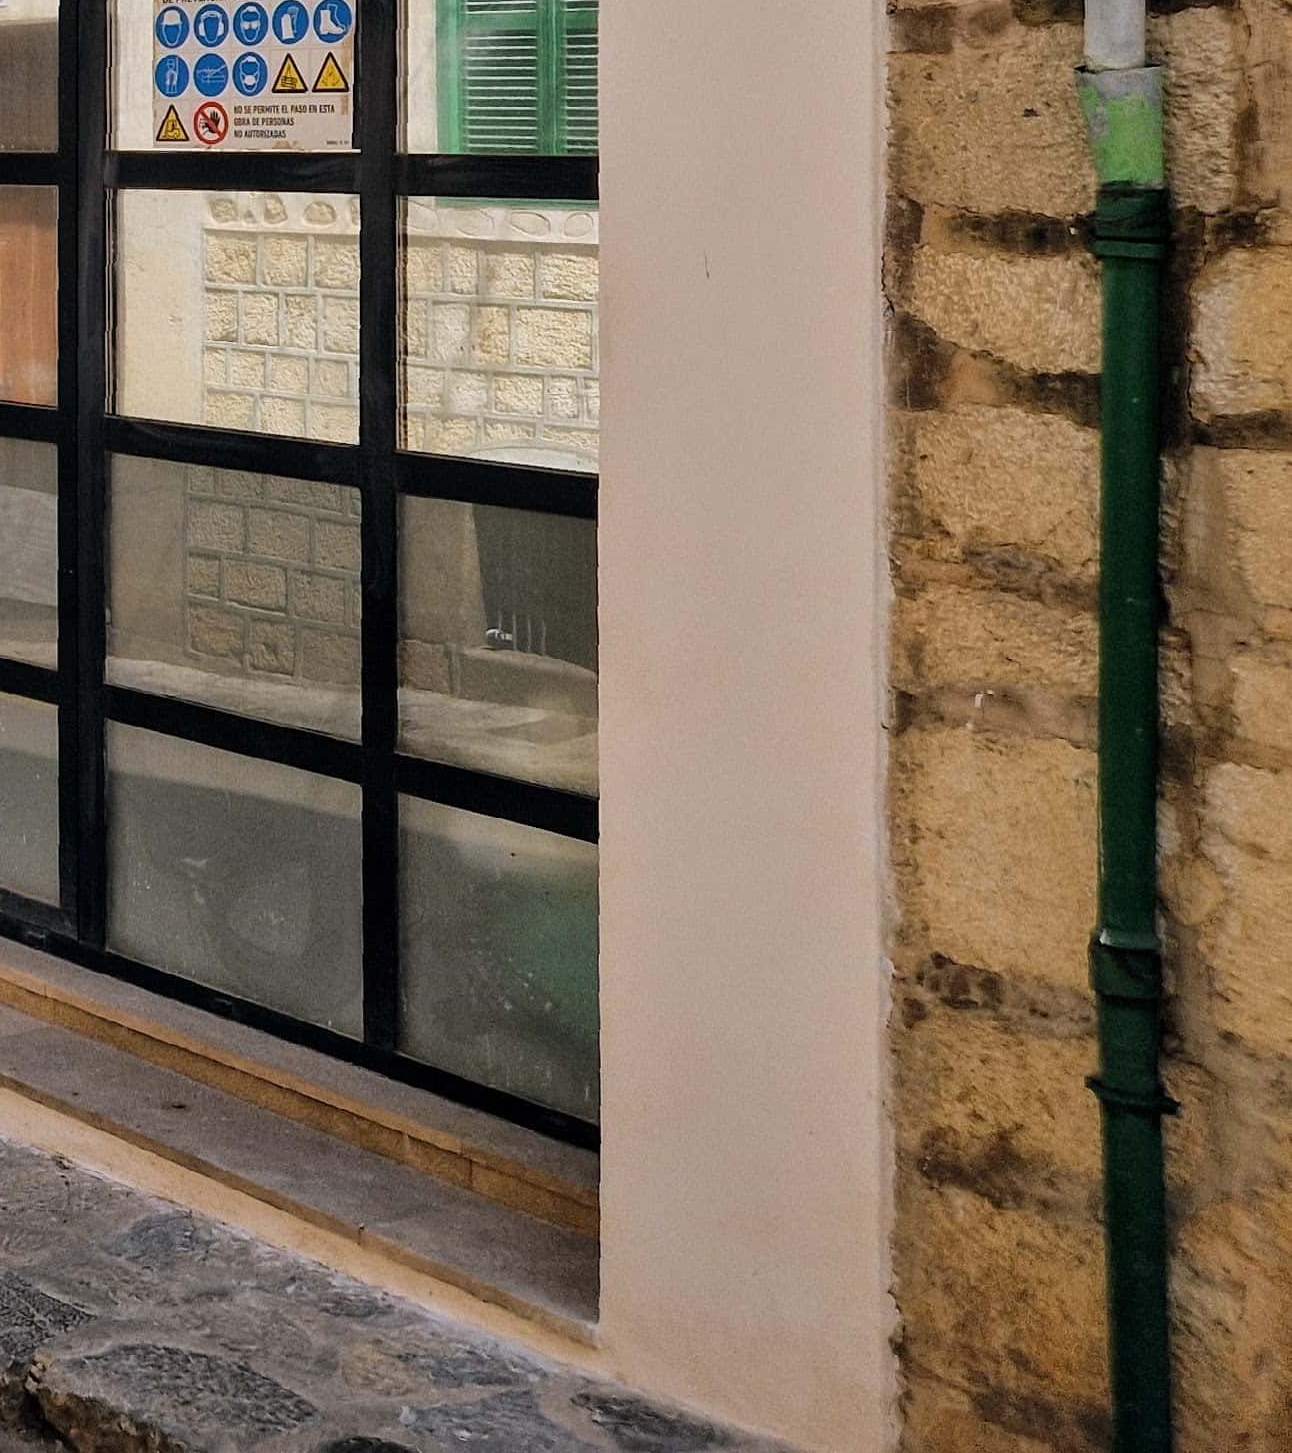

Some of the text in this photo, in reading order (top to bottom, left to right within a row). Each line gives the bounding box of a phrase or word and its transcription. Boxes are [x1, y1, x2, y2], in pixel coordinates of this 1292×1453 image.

[234, 105, 243, 114] NO
[253, 105, 280, 114] PERMITE
[281, 105, 289, 114] EL
[319, 104, 335, 114] ESTA
[234, 130, 243, 138] NO
